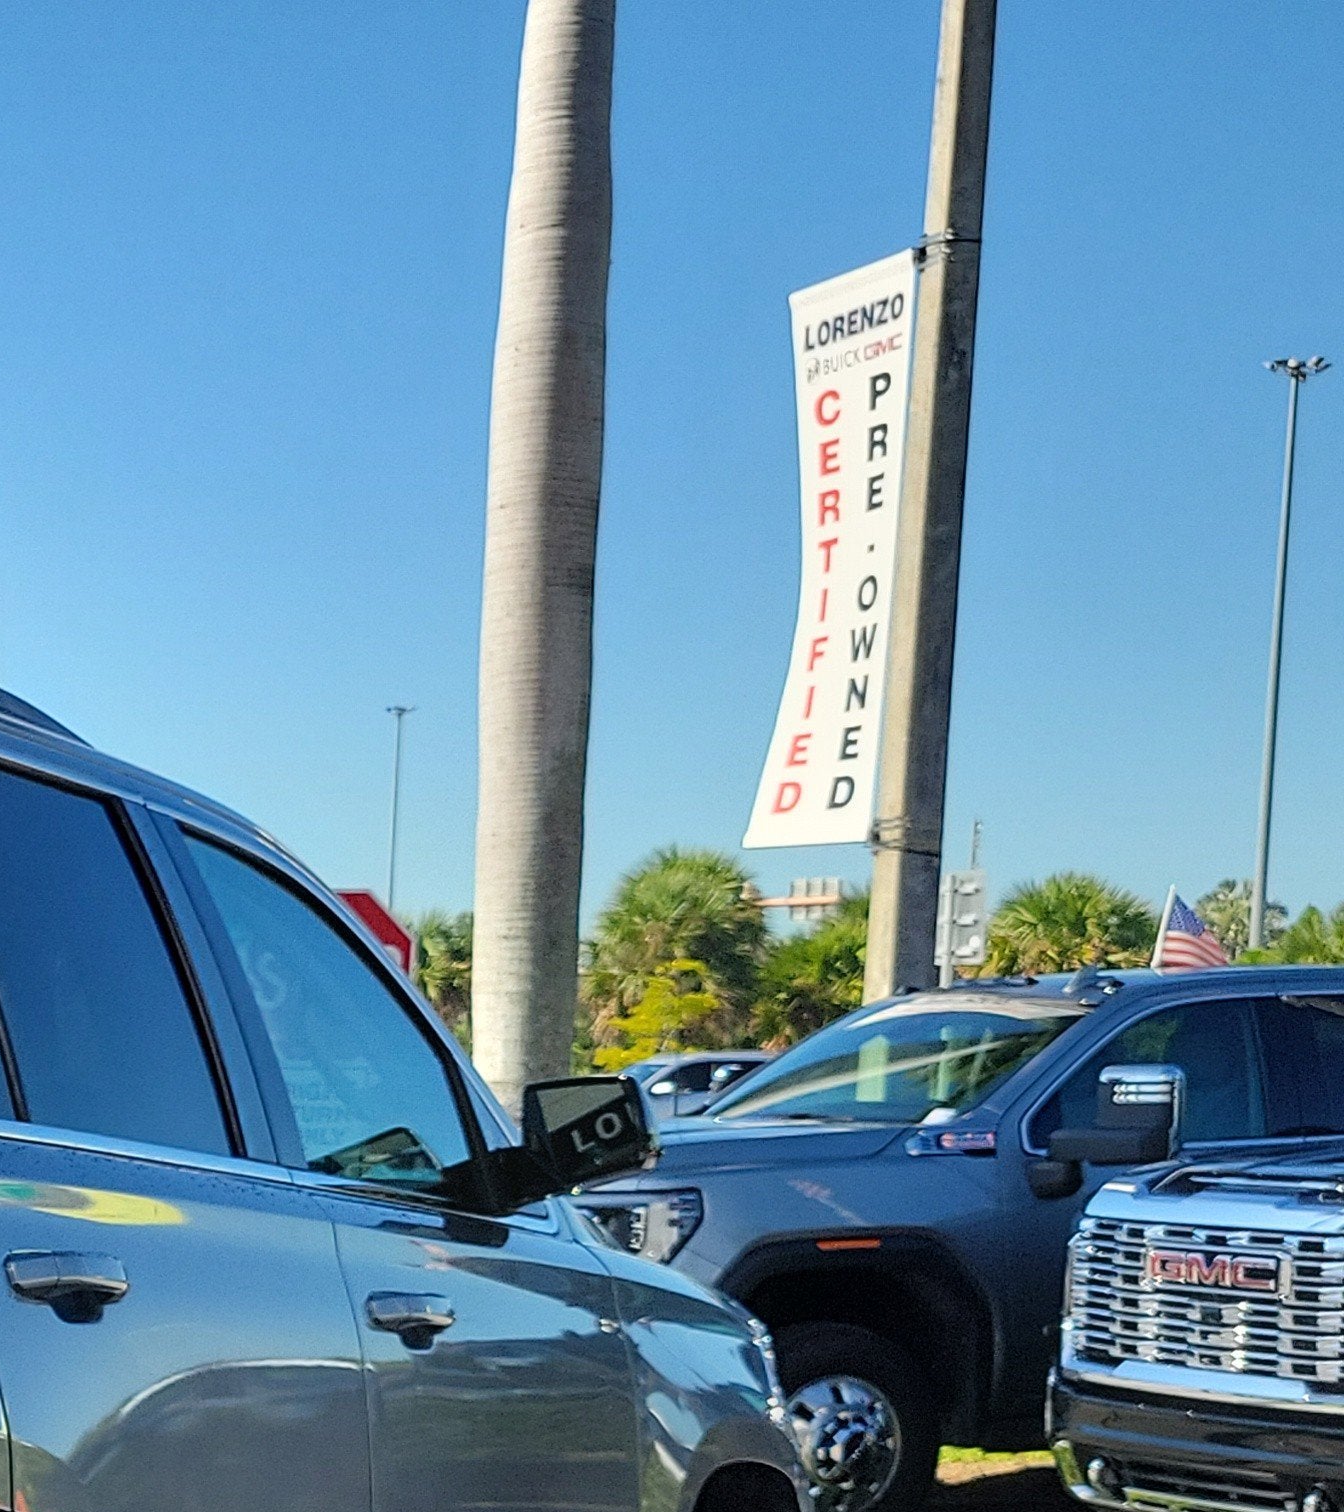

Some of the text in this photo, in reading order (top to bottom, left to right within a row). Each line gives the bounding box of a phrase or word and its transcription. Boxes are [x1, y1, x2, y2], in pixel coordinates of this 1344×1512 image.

[804, 292, 904, 351] LORENZO
[822, 332, 903, 376] BUICK GMC
[773, 389, 841, 815] CERTIFIED
[1150, 1250, 1278, 1292] GMC
